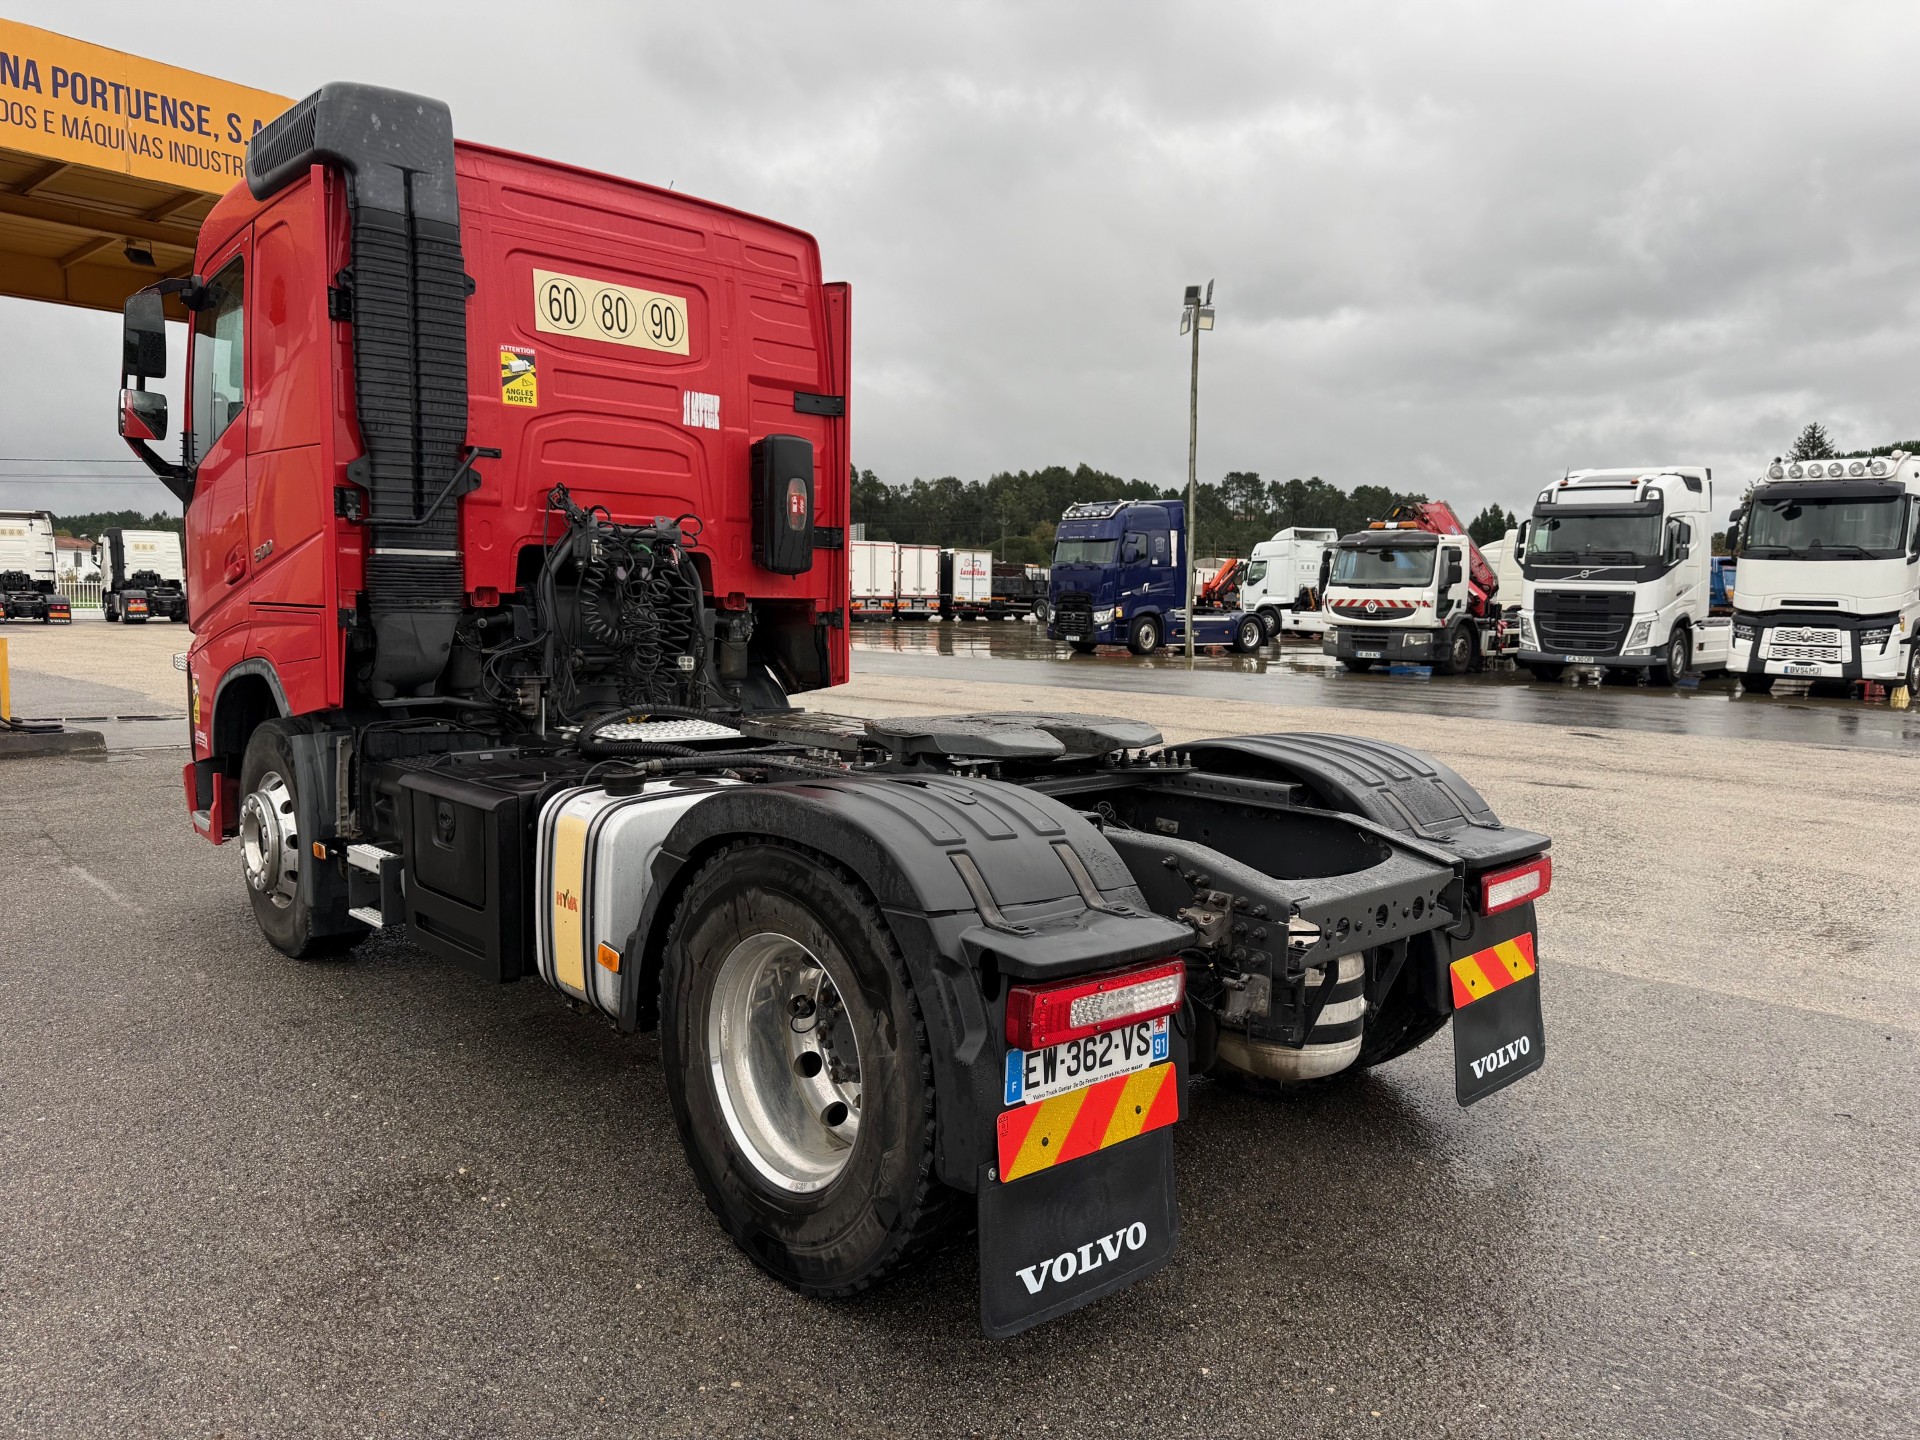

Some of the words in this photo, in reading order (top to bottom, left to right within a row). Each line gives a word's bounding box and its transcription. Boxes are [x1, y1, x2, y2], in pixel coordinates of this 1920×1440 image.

[52, 65, 219, 142] PORTUENSE,
[44, 109, 55, 134] E
[62, 114, 163, 159] MÁQUINAS
[549, 284, 577, 324] 60
[602, 294, 628, 333] 80
[651, 304, 676, 342] 90
[500, 345, 536, 355] ATTENTION
[506, 388, 534, 397] ANGLES
[507, 395, 533, 404] MORTS
[253, 539, 273, 562] 500
[556, 889, 578, 912] HYVA
[1025, 1022, 1150, 1090] EW-362-VS
[1155, 1038, 1166, 1054] 91
[1470, 1035, 1530, 1080] VOLVO
[1011, 1082, 1017, 1093] F
[1015, 1221, 1147, 1295] VOLVO
